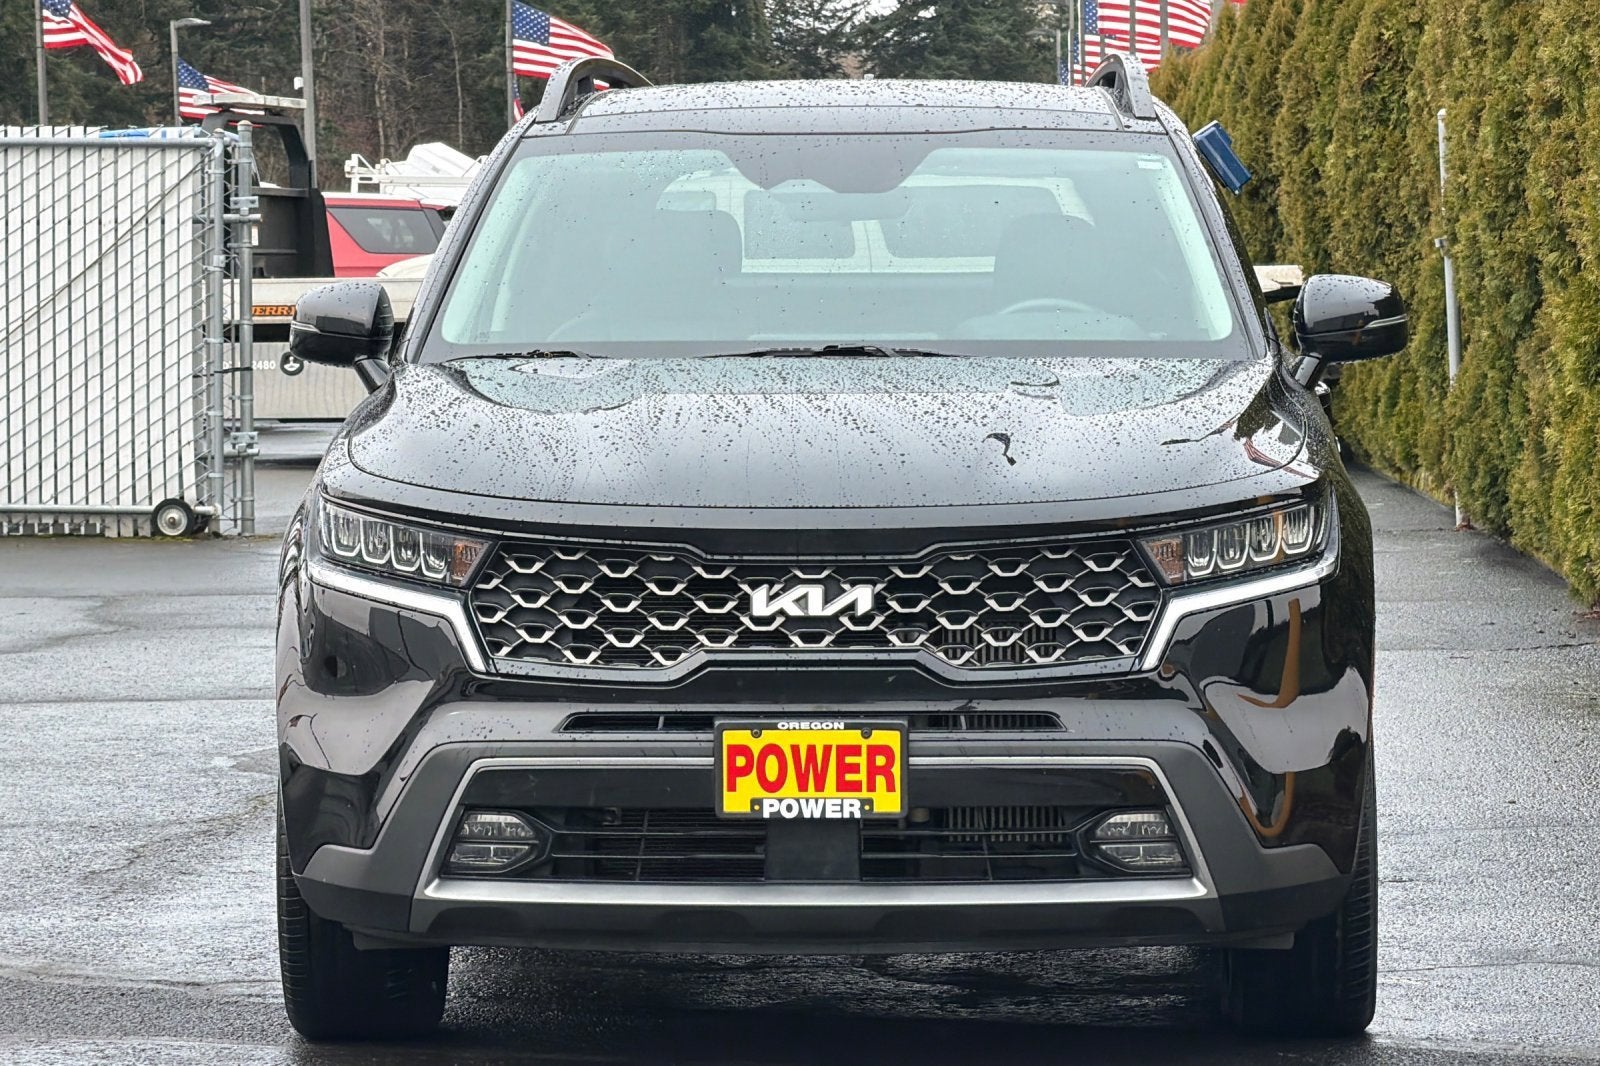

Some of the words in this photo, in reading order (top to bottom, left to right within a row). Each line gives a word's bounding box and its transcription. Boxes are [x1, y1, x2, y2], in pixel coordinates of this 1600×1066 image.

[752, 584, 875, 617] KIA
[777, 721, 845, 730] OREGON
[726, 743, 897, 793] POWER
[762, 798, 862, 819] POWER
